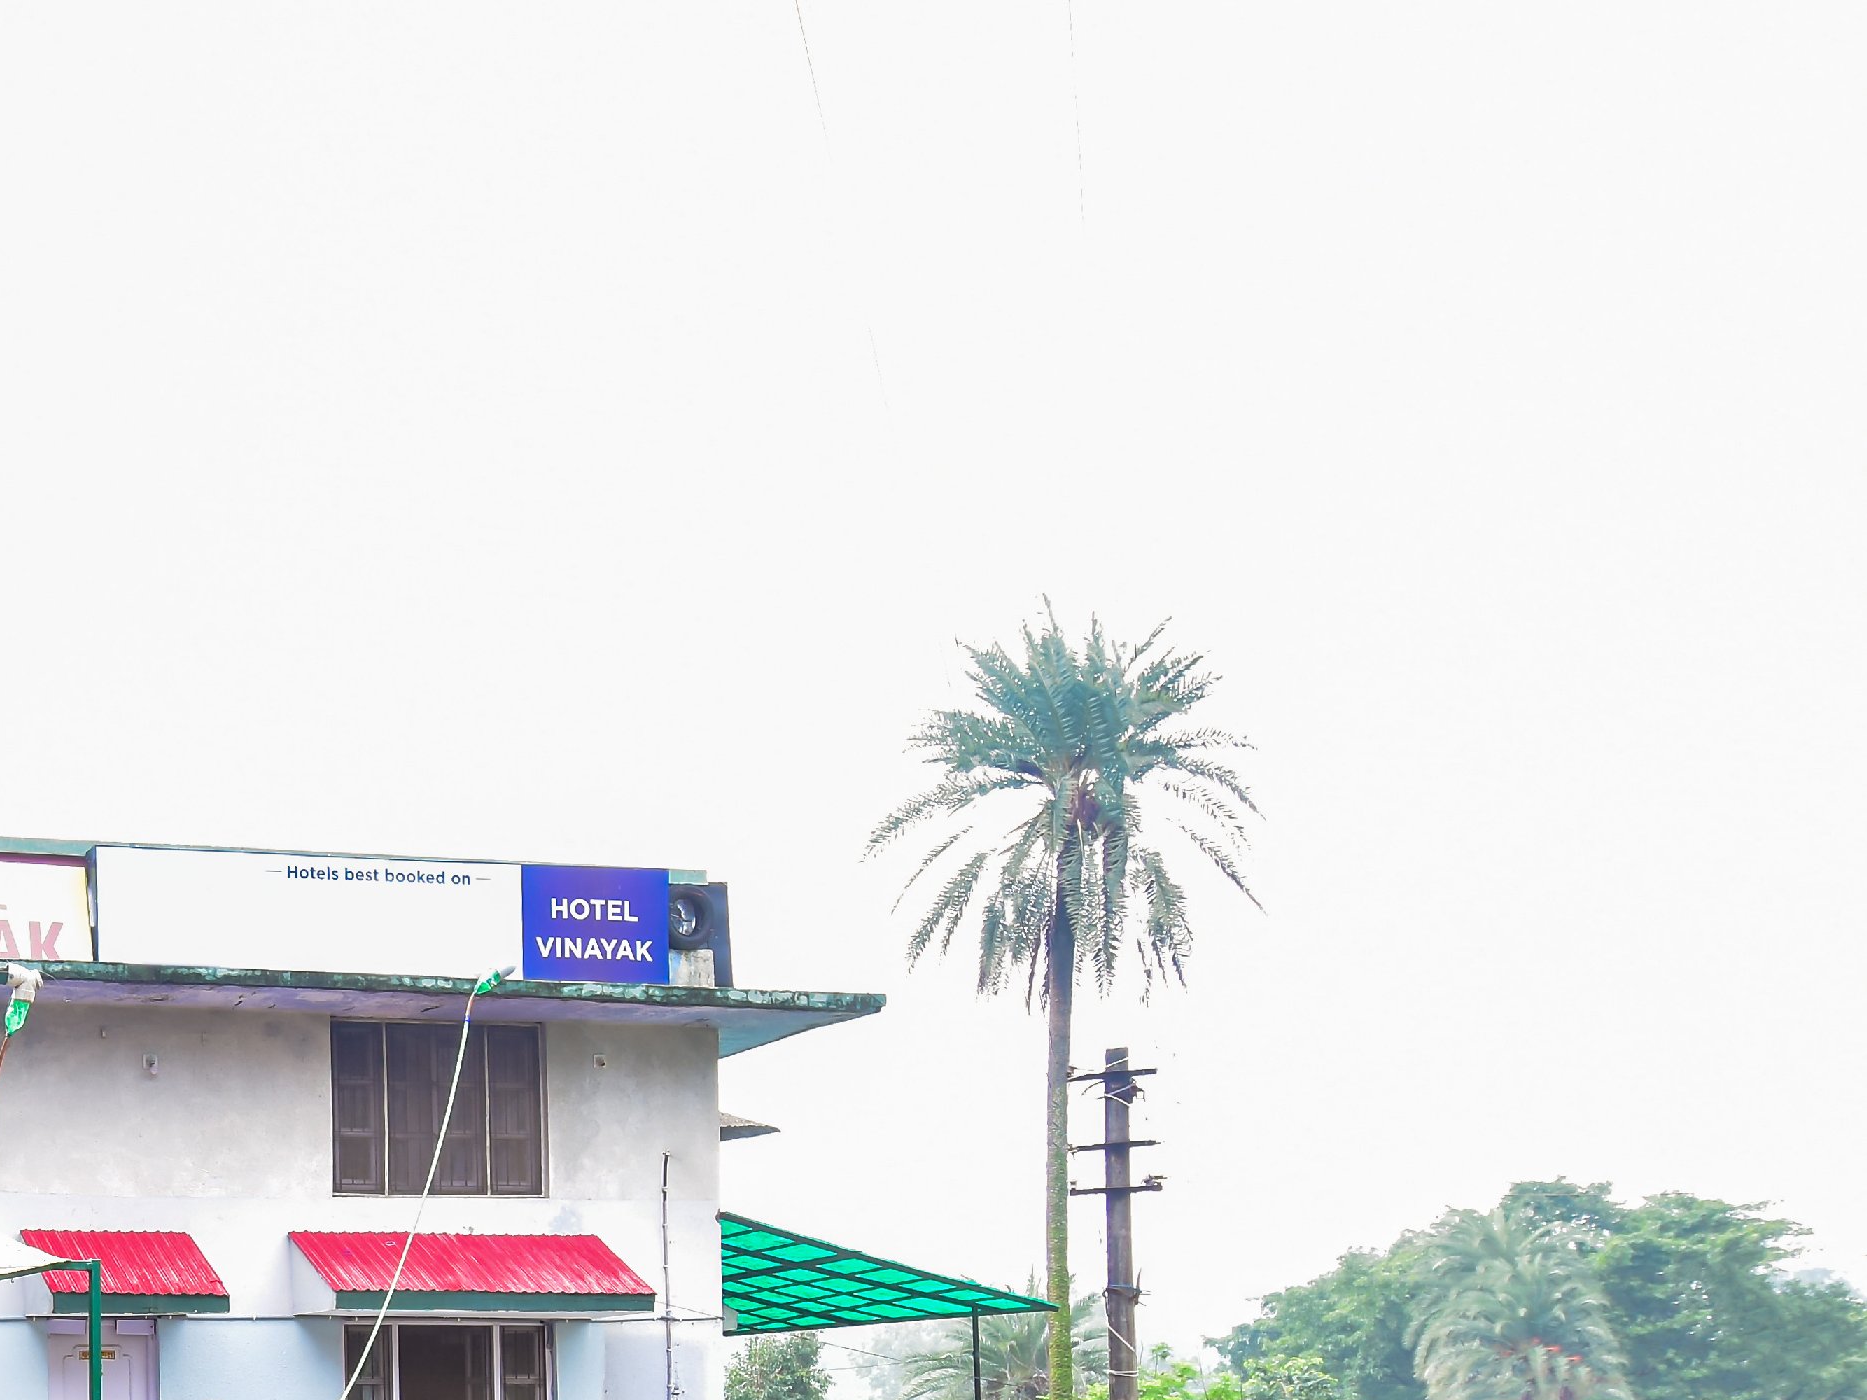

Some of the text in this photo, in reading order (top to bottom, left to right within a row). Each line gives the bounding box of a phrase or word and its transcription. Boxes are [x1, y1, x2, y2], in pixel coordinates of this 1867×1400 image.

[287, 866, 471, 886] Hotels best booked on
[550, 897, 639, 923] HOTEL
[535, 935, 654, 962] VINAYAK
